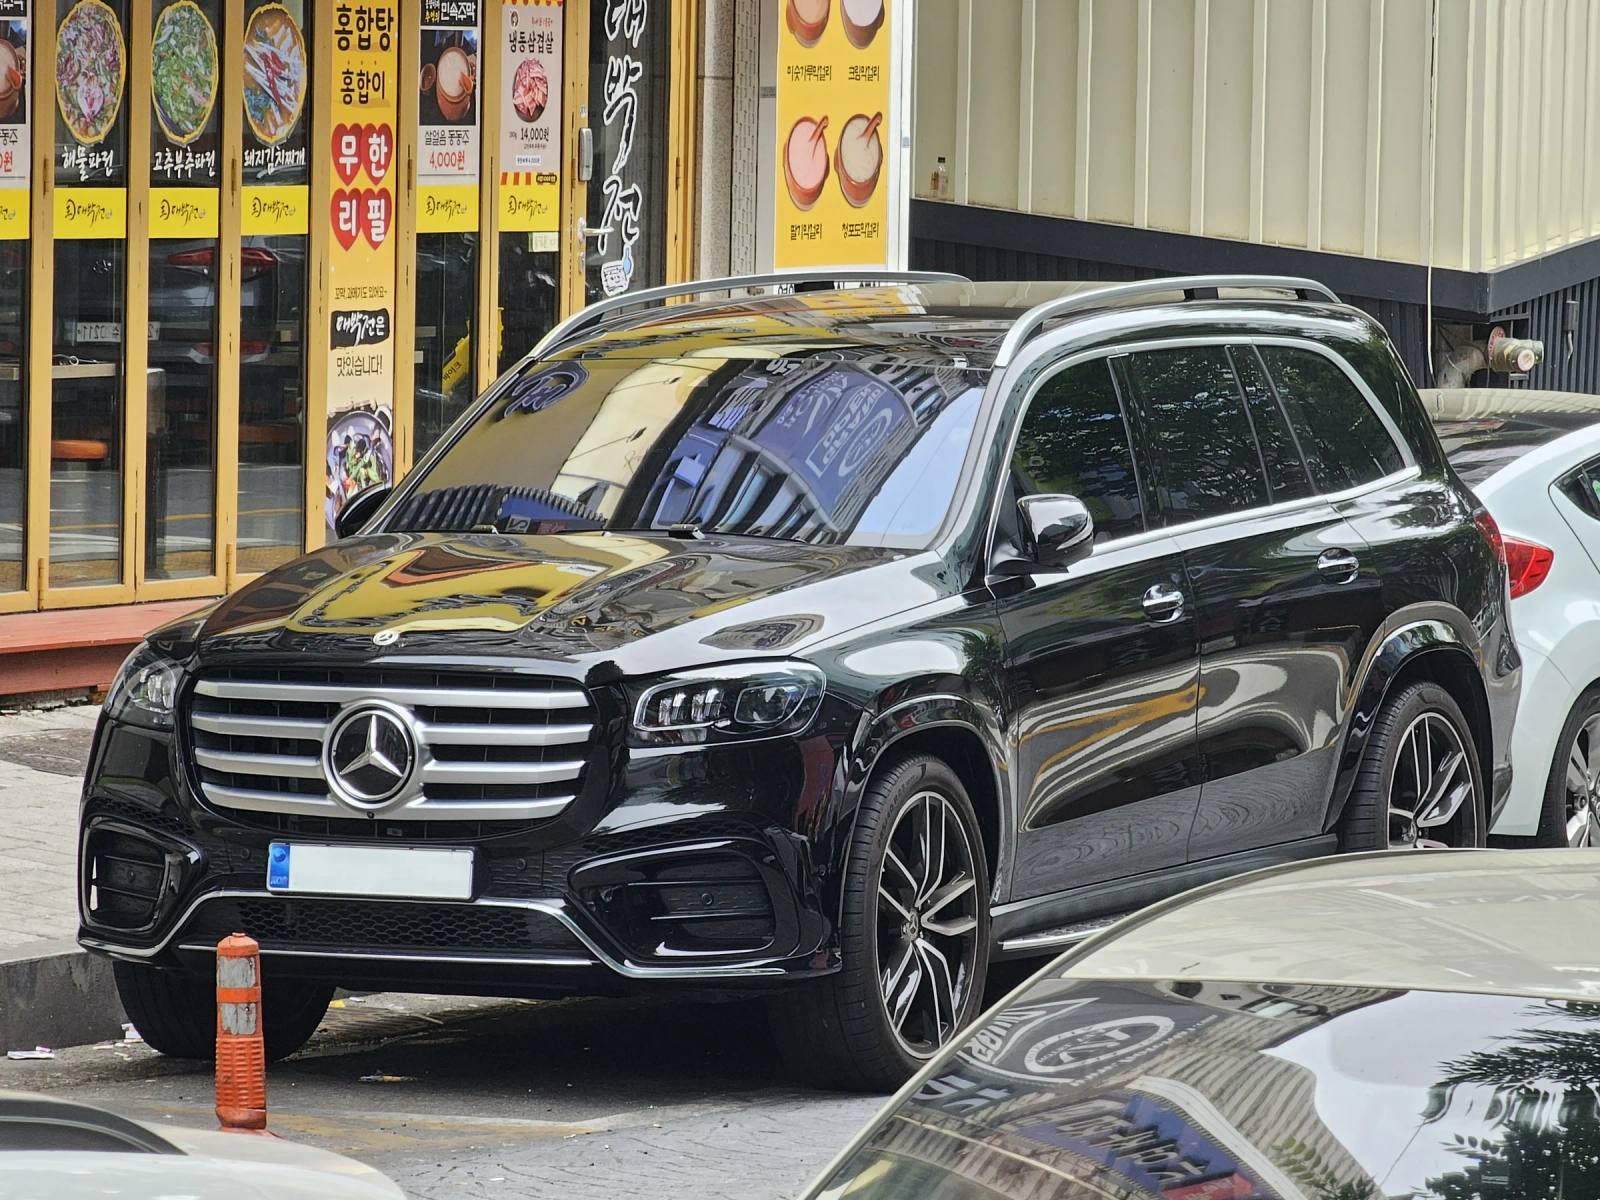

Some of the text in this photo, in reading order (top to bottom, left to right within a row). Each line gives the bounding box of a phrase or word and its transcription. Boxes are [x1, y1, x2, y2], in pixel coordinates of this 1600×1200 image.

[440, 1, 476, 22] 민속주막
[334, 3, 394, 51] 홍합탕
[509, 30, 554, 54] 냉동삼겹살
[787, 65, 832, 81] 미숫가루막걸리
[848, 65, 880, 82] 크림막걸리
[340, 68, 385, 105] 홍합이
[0, 128, 18, 146] 동주
[425, 129, 470, 146] 살얼음 동동주
[520, 127, 549, 142] 14,000원
[61, 145, 114, 182] 해물파전
[152, 145, 216, 179] 고추부추파전
[244, 145, 306, 176] 돼지김치찌개
[338, 133, 388, 177] 무한
[429, 150, 465, 171] 4,000원
[338, 198, 386, 242] 리필
[790, 223, 823, 240] 딸기막걸리
[841, 222, 880, 238] 청포도막걸리
[335, 311, 386, 347] 대박전은
[336, 354, 383, 377] 맛있습니다!
